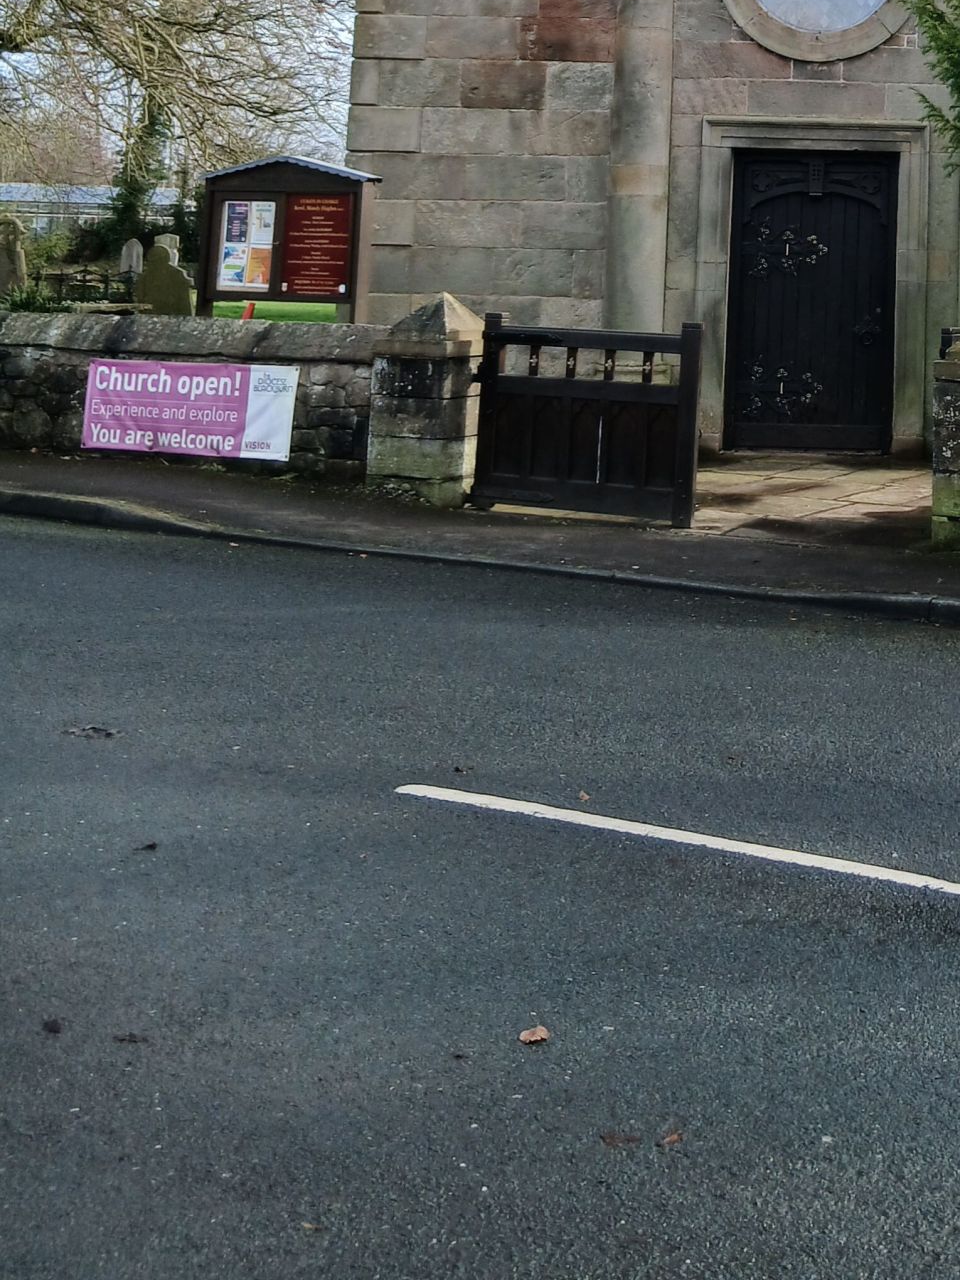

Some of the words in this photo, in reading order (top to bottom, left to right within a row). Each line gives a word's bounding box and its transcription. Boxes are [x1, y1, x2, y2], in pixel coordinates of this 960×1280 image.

[95, 365, 171, 393] Church
[177, 371, 242, 400] open!
[91, 400, 159, 419] Experience
[162, 404, 186, 420] and
[189, 405, 238, 425] explore
[90, 423, 121, 444] You
[124, 429, 154, 446] are
[157, 430, 235, 451] welcome
[244, 441, 271, 450] VISION
